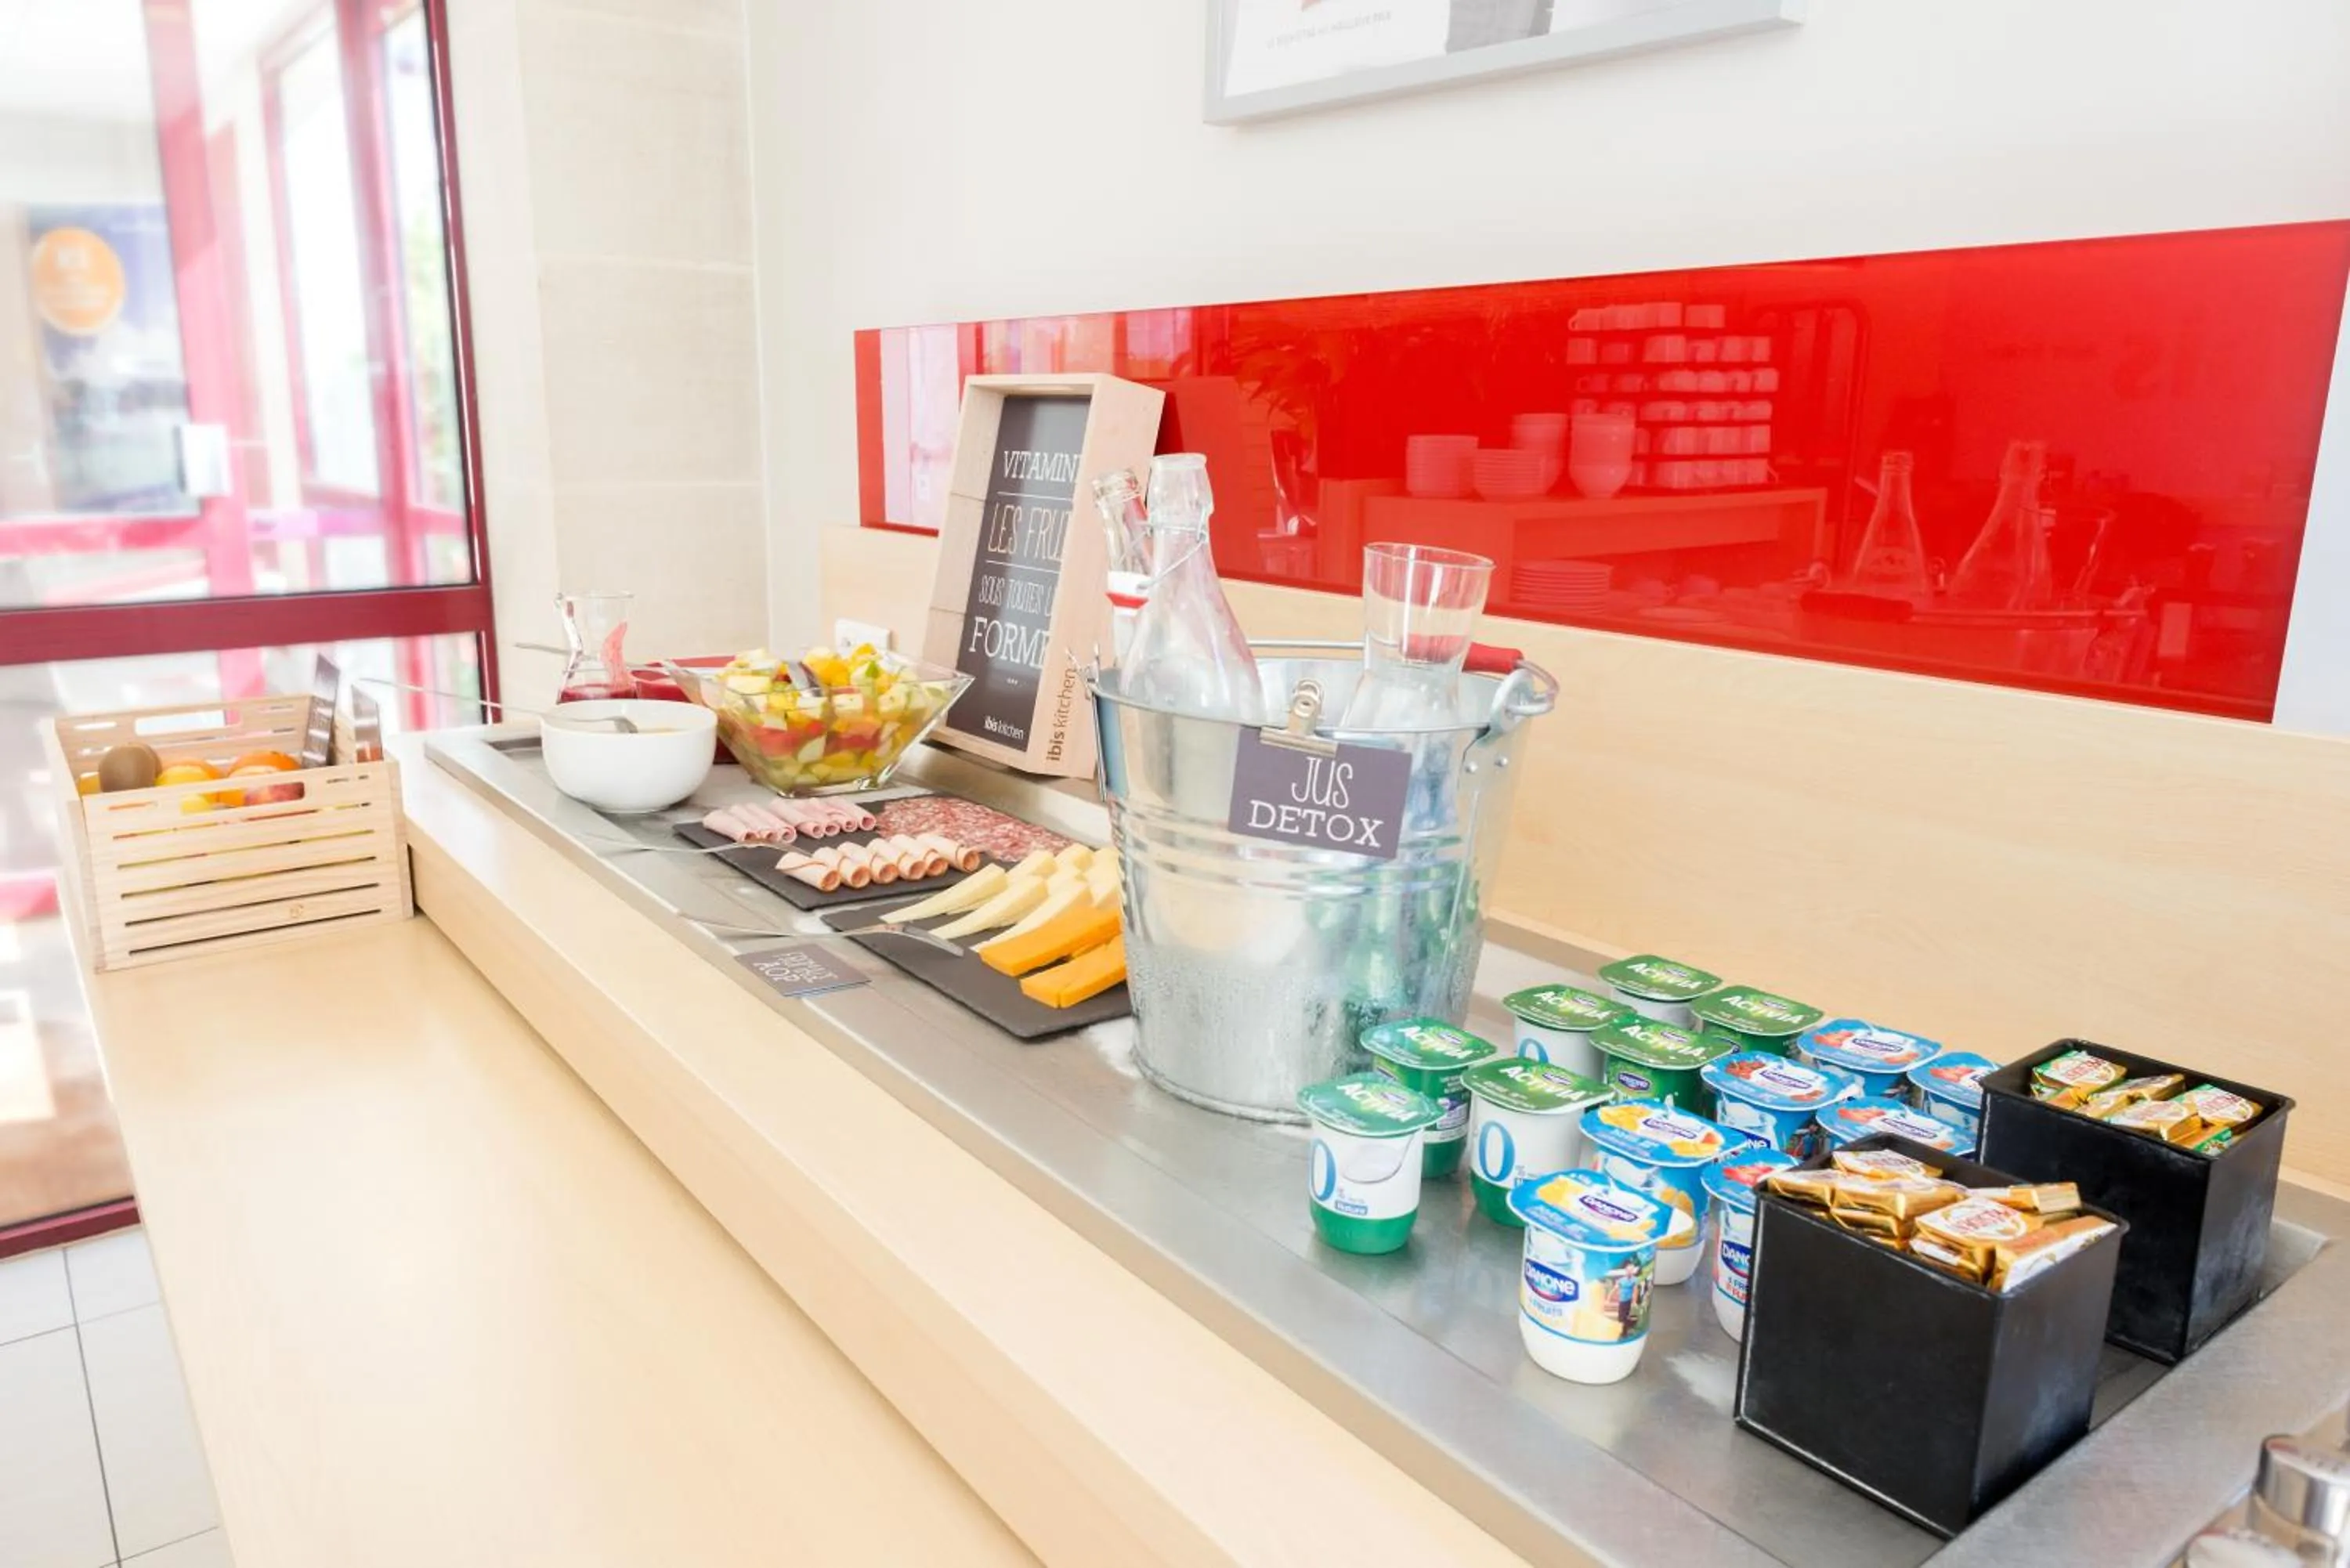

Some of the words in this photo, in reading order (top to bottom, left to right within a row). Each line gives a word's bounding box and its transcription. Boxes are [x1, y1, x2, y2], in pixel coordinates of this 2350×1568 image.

[1003, 451, 1080, 482] VITAMIN
[988, 502, 1022, 555] LES
[979, 575, 1005, 605] SOUS
[1006, 578, 1044, 615] TOUTES
[984, 715, 998, 732] ibis
[998, 720, 1024, 740] kitchen
[1047, 729, 1065, 761] ibis
[1057, 667, 1078, 731] kitchen
[1291, 756, 1353, 809] JUS
[1247, 800, 1384, 847] DETOX
[1525, 1261, 1575, 1295] DANONE
